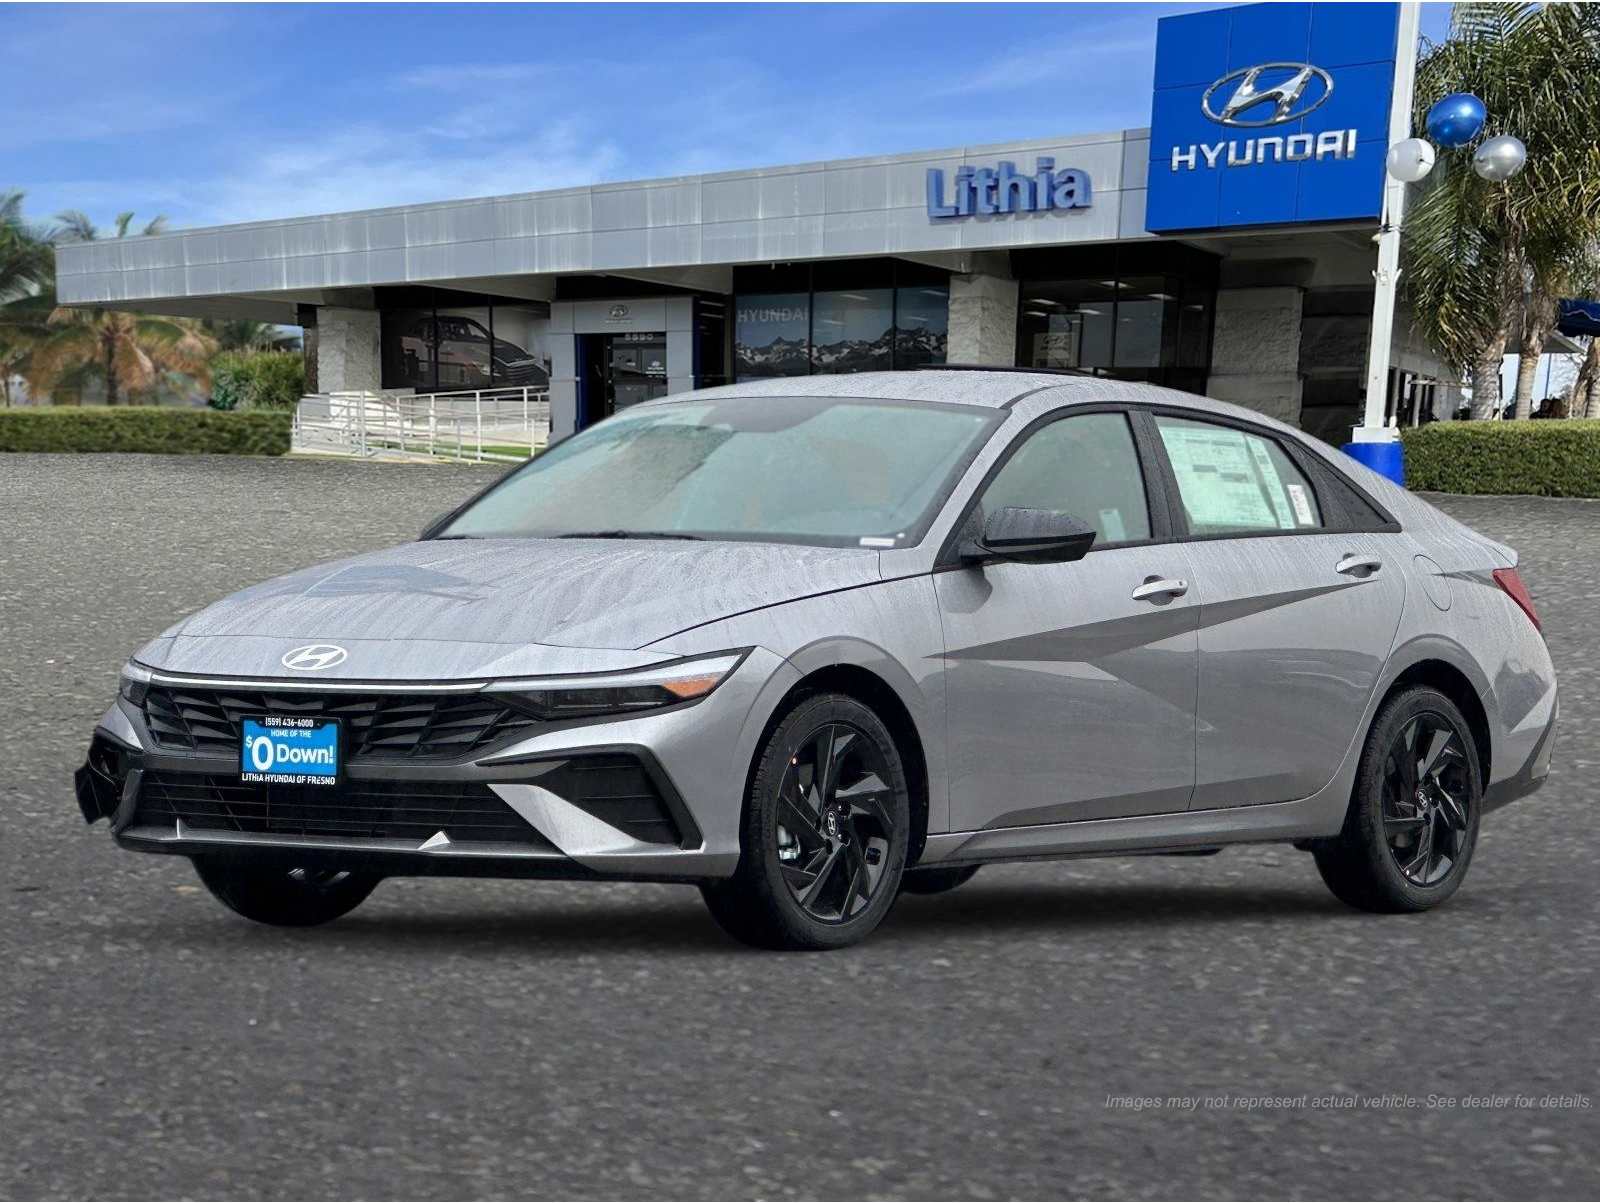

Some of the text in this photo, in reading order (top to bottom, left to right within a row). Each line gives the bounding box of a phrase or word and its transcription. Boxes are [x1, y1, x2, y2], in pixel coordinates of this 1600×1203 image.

[1171, 128, 1357, 172] HYUNDAI
[926, 156, 1093, 218] Lithia
[737, 307, 809, 322] HYUNDAI
[265, 717, 314, 728] (559) 436-6000
[271, 729, 312, 738] HOME OF THE
[276, 743, 334, 764] Down!
[241, 772, 336, 785] LITHIA HYUNDAI OF FRESNO
